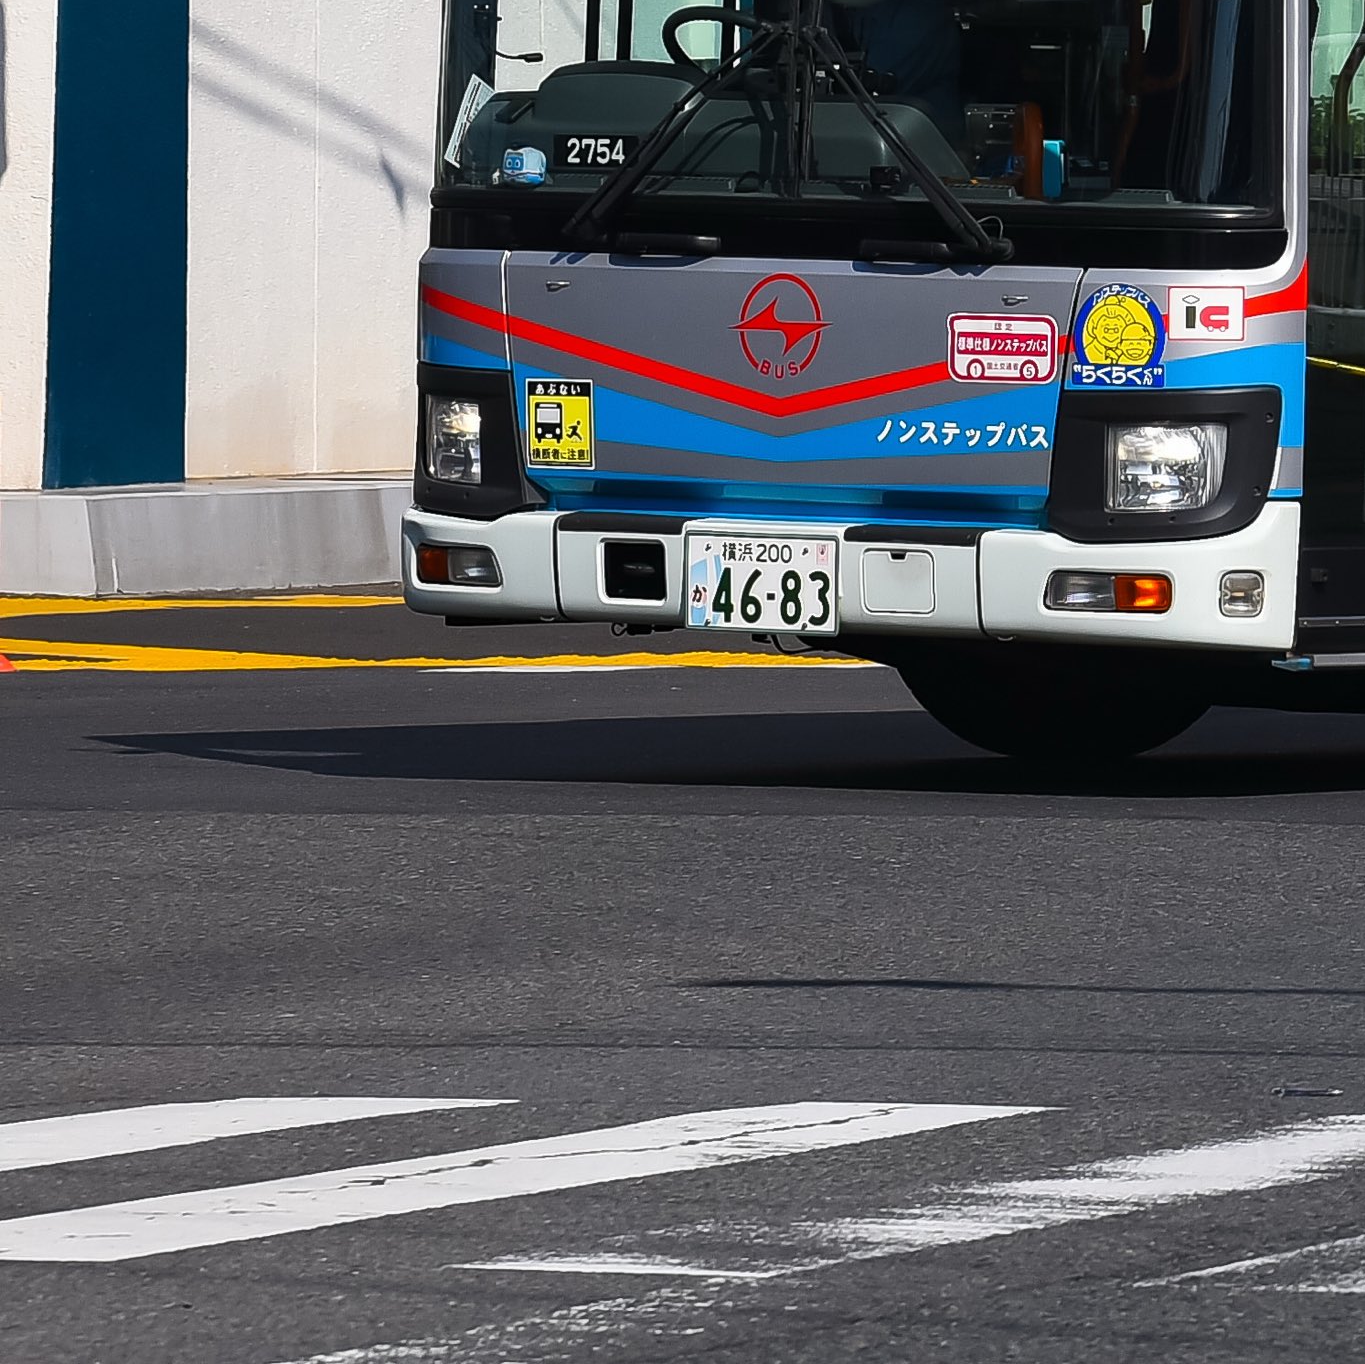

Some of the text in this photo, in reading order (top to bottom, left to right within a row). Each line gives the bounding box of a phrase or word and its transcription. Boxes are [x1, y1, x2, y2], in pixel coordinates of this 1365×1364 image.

[567, 138, 625, 164] 2754
[758, 360, 799, 379] BUS
[1026, 367, 1033, 376] 5
[536, 384, 580, 394] あぶない
[877, 420, 1049, 449] ノンステップバス
[722, 542, 792, 563] 横浜200
[692, 567, 830, 626] か 46-83
